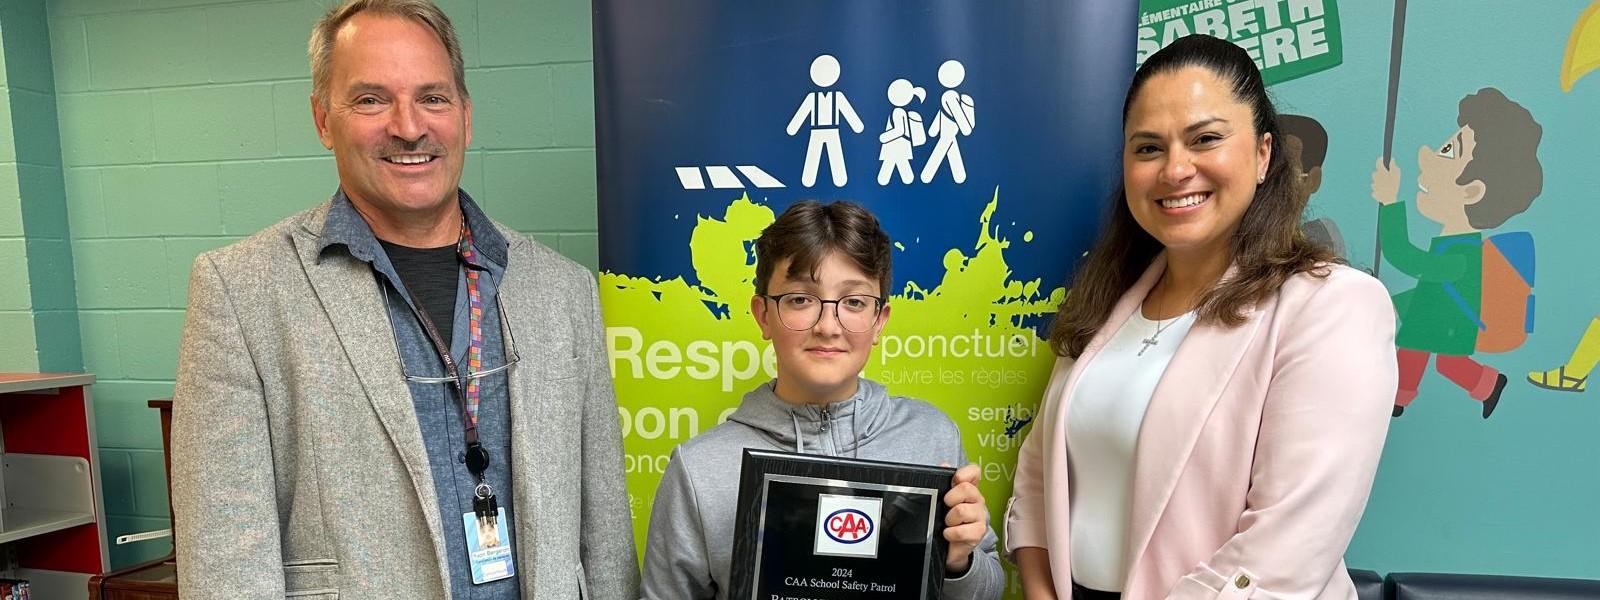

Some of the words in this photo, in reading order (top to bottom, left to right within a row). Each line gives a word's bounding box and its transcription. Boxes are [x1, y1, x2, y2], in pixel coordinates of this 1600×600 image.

[881, 326, 1037, 365] ponctuel
[881, 367, 932, 385] suivre
[939, 367, 964, 385] les
[971, 367, 1027, 388] règles
[830, 513, 867, 539] CAA
[831, 568, 853, 578] 2024
[784, 576, 808, 587] CAA
[810, 578, 840, 589] School
[841, 580, 868, 592] Safety
[870, 582, 896, 592] Patrol
